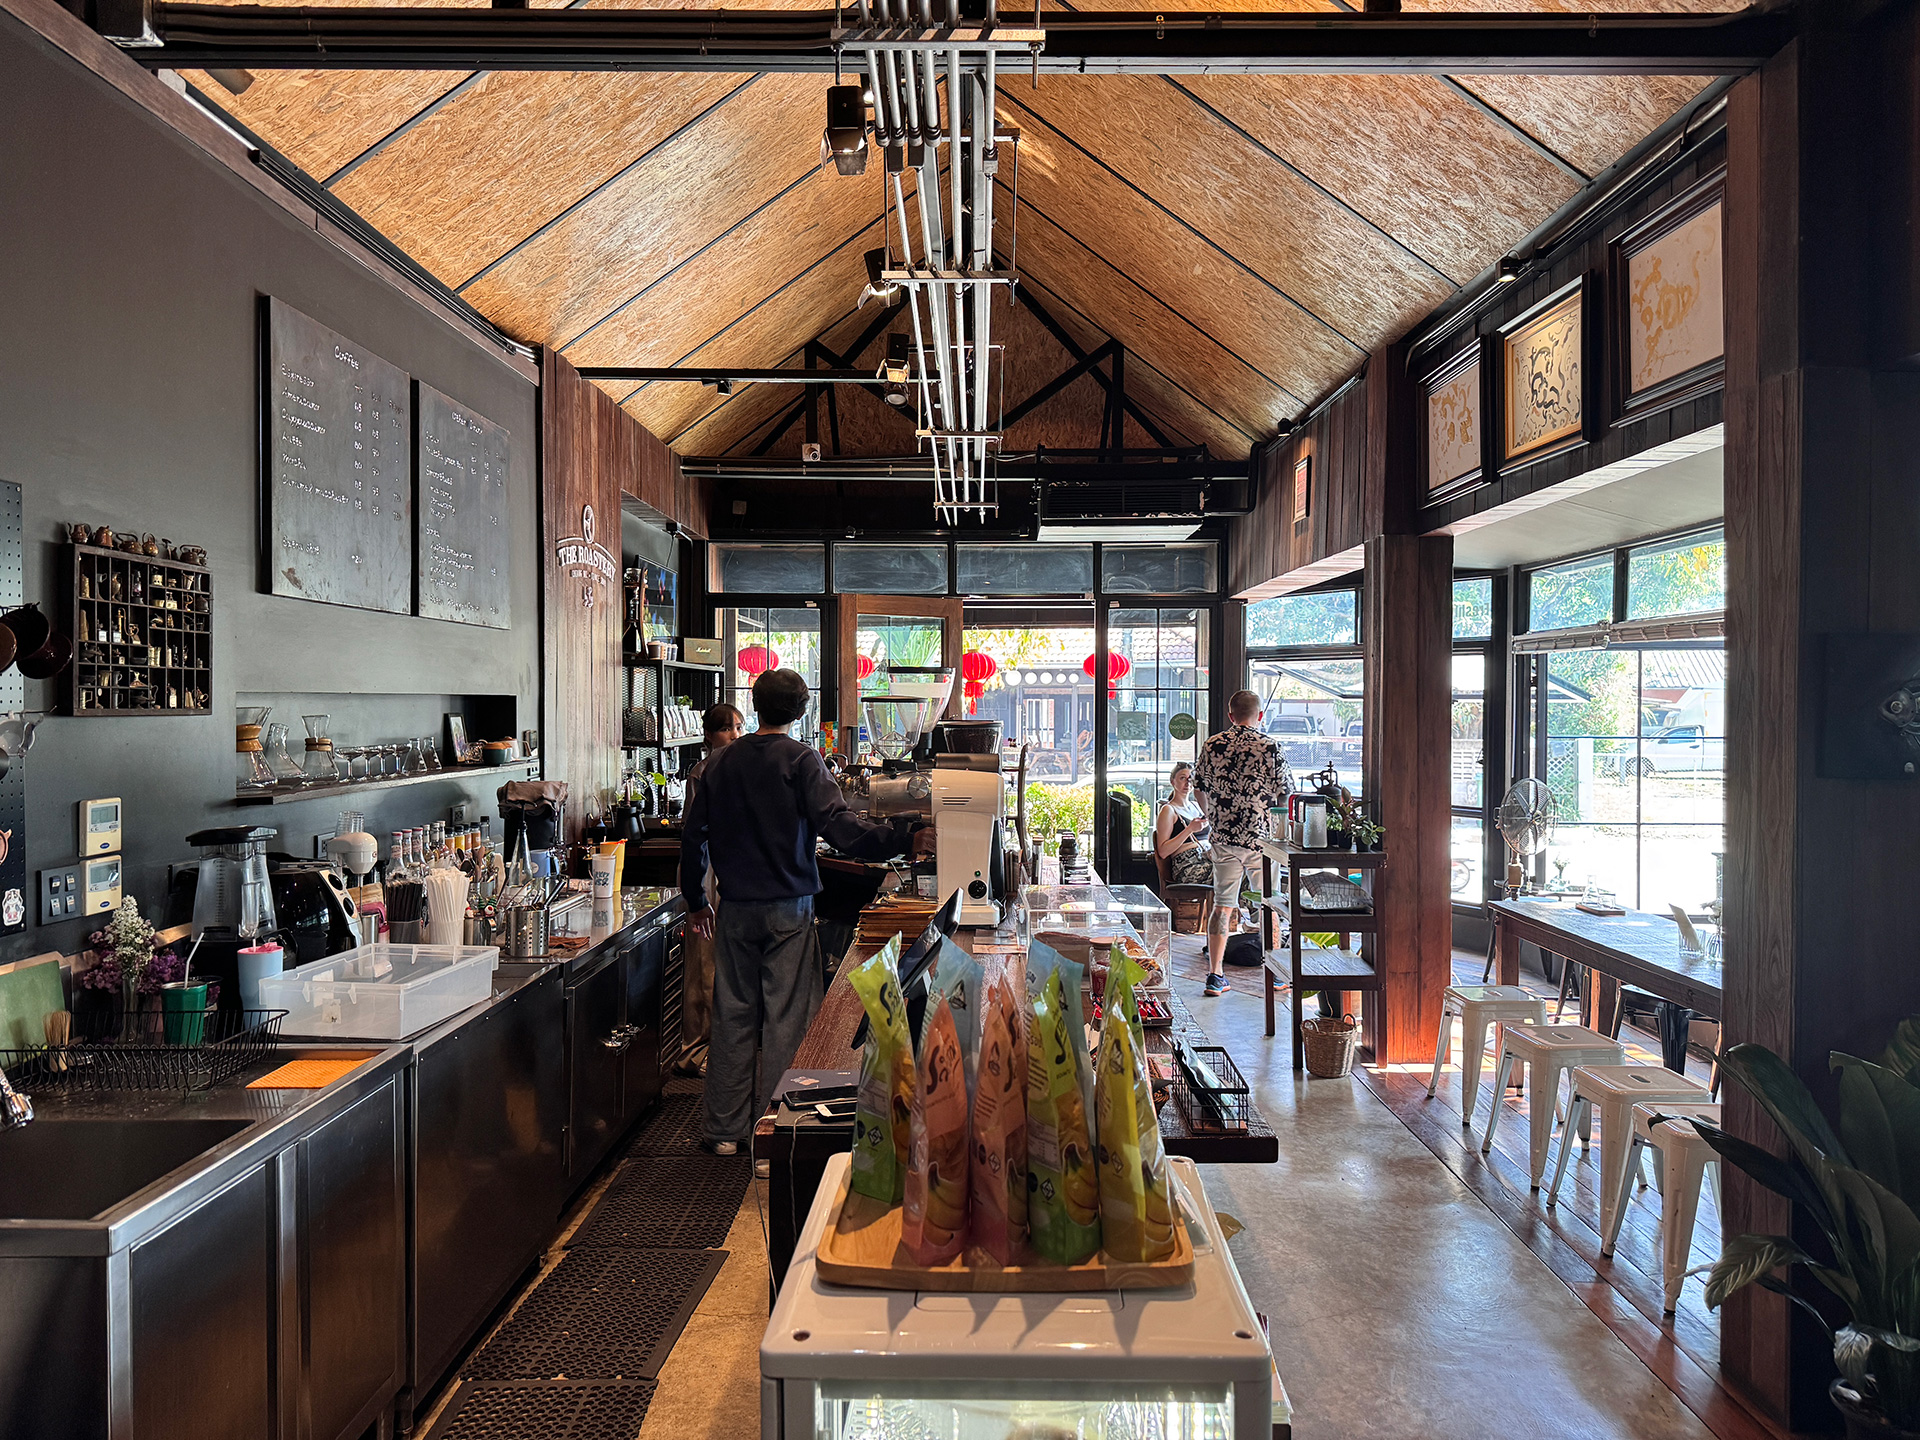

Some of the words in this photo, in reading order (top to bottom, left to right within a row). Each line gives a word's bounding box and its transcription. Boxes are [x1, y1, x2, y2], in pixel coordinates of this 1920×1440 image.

[334, 345, 359, 370] Coffee
[281, 363, 315, 388] Espresso
[354, 401, 362, 413] 65
[281, 386, 320, 411] Americano
[354, 421, 362, 432] 65
[281, 408, 326, 435] Cappuccino
[354, 440, 363, 450] 80
[354, 459, 363, 470] 80
[558, 545, 577, 567] THE
[578, 545, 617, 583] ROASTERY
